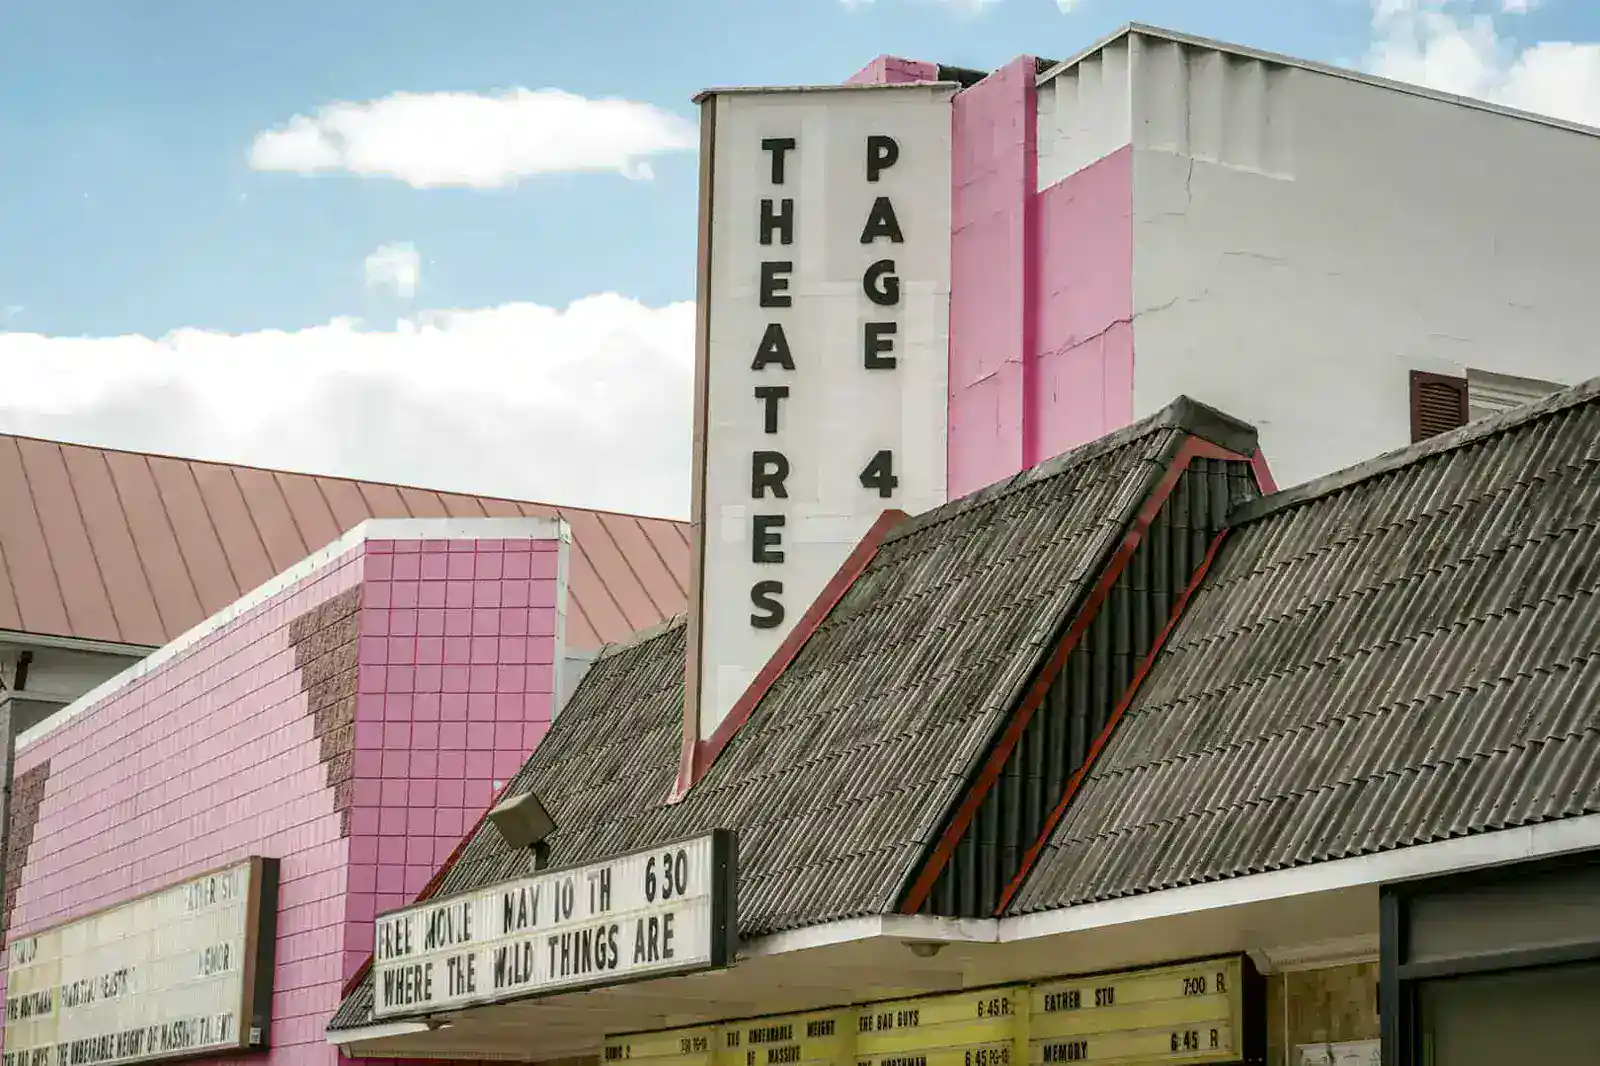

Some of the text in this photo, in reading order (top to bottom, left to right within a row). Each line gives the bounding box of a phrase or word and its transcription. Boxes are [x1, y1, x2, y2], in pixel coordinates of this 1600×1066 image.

[859, 134, 904, 498] PAGE 4
[750, 137, 796, 629] THEATRES
[378, 917, 412, 960] FREE
[425, 902, 472, 950] MOVIE
[504, 885, 541, 934] MAY
[554, 876, 574, 923] 10
[587, 867, 612, 914] TH
[383, 912, 675, 1007] WHERE THE WILD THINGS ARE
[859, 1015, 873, 1032] THE
[877, 1013, 893, 1030] BAD
[897, 1010, 920, 1027] GUYS
[1044, 990, 1081, 1012] FATHER
[1094, 986, 1115, 1007] STU
[1216, 973, 1226, 993] R
[1043, 1040, 1088, 1064] MEMORY
[1210, 1028, 1219, 1048] R
